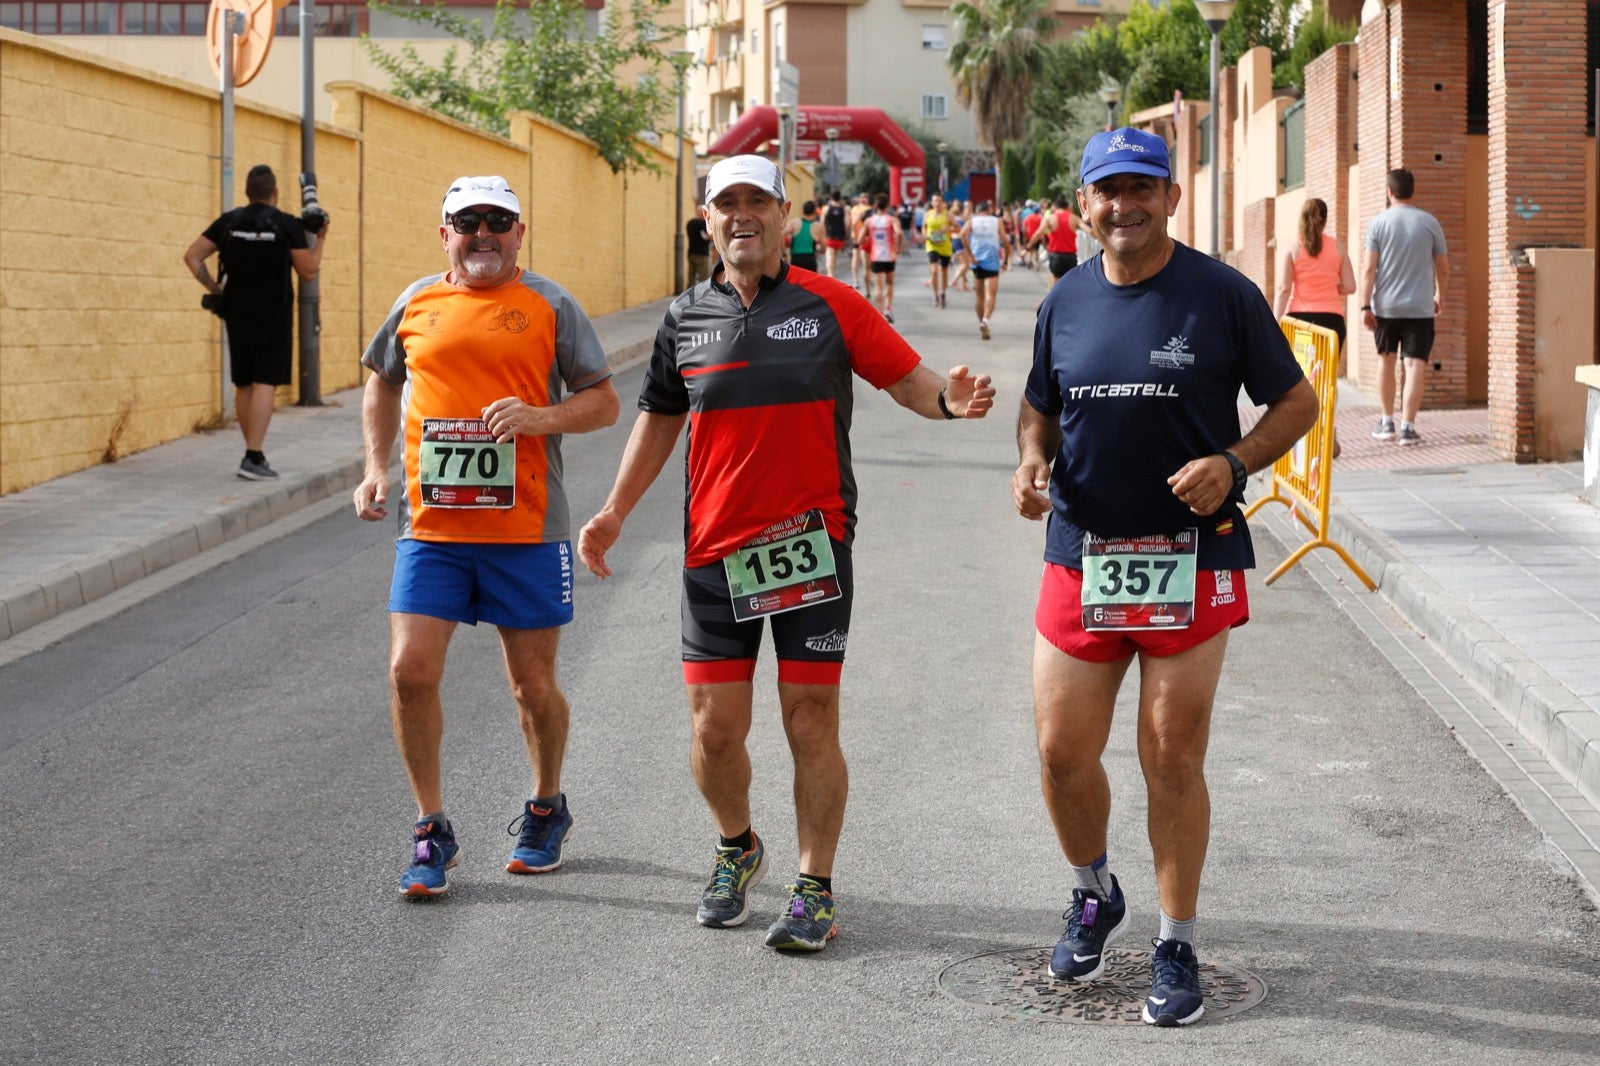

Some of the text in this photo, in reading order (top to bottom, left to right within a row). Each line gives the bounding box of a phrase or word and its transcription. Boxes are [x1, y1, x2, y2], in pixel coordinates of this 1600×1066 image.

[439, 421, 455, 431] GRAN
[456, 422, 478, 432] PREMIO
[479, 422, 487, 432] DE
[434, 447, 499, 479] 770
[772, 526, 802, 541] CRUZCAMPO
[1105, 543, 1171, 553] DIPUTACIÓN CRUZCAMPO
[559, 542, 571, 604] SMITH
[745, 539, 818, 585] 153
[1099, 560, 1178, 596] 357
